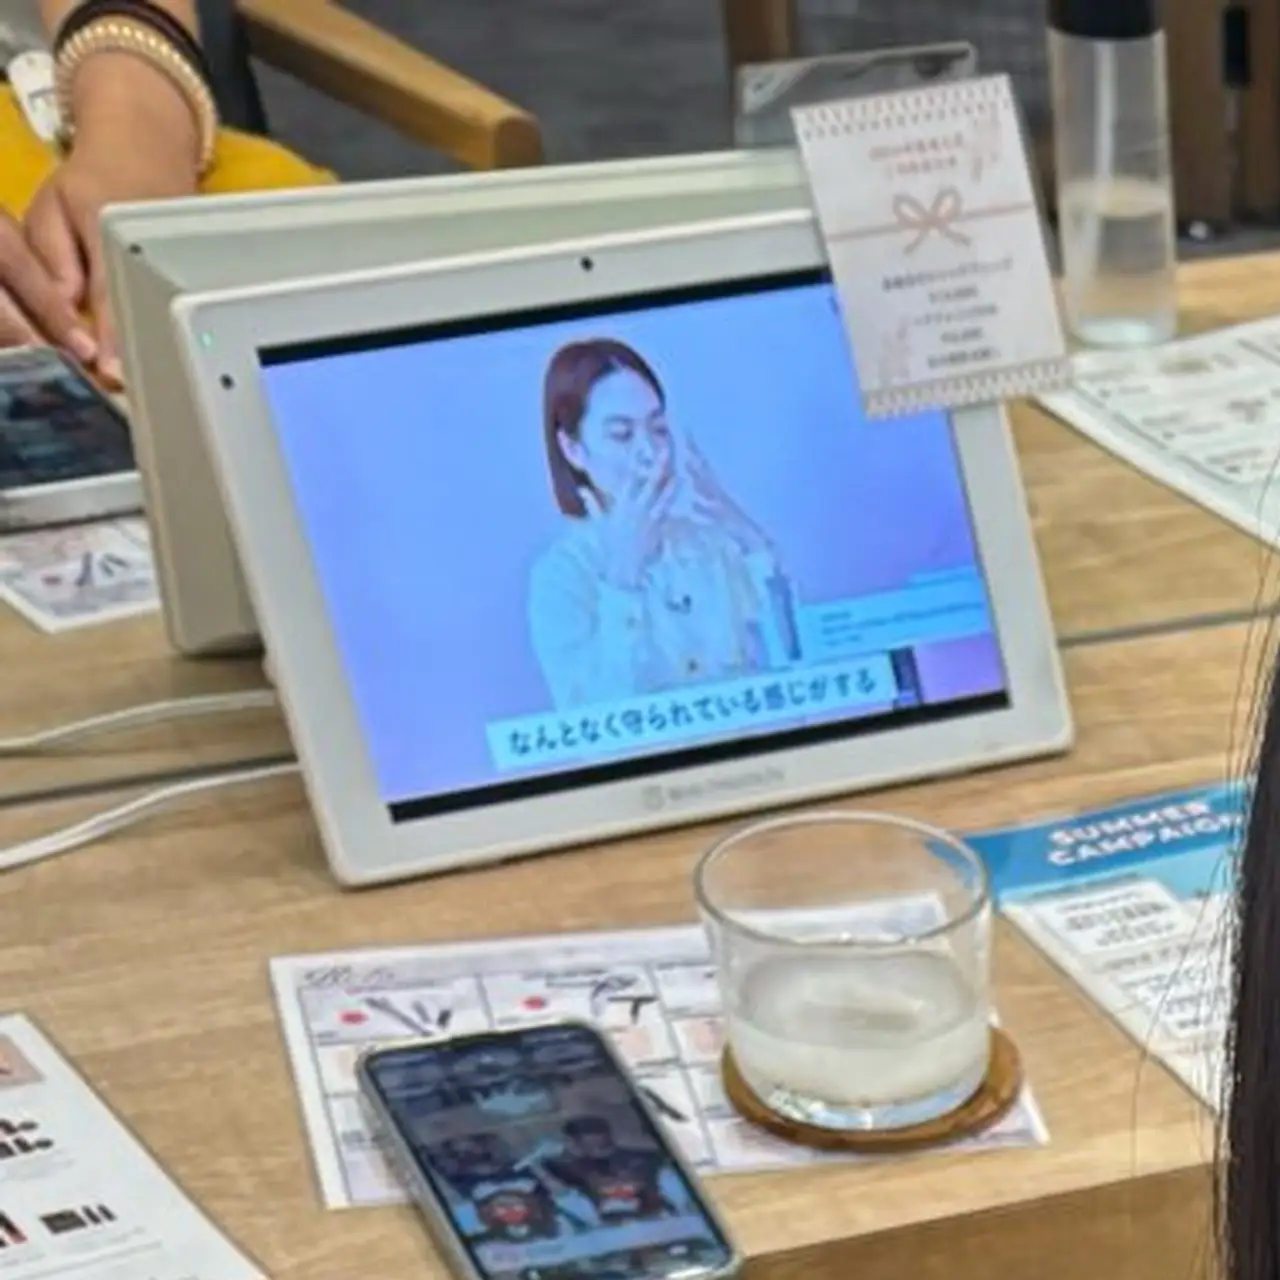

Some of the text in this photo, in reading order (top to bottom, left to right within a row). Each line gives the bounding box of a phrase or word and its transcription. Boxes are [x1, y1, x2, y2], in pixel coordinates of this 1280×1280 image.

[508, 667, 877, 757] なんとなく守られている感じがする
[1050, 802, 1210, 846] SUMMER
